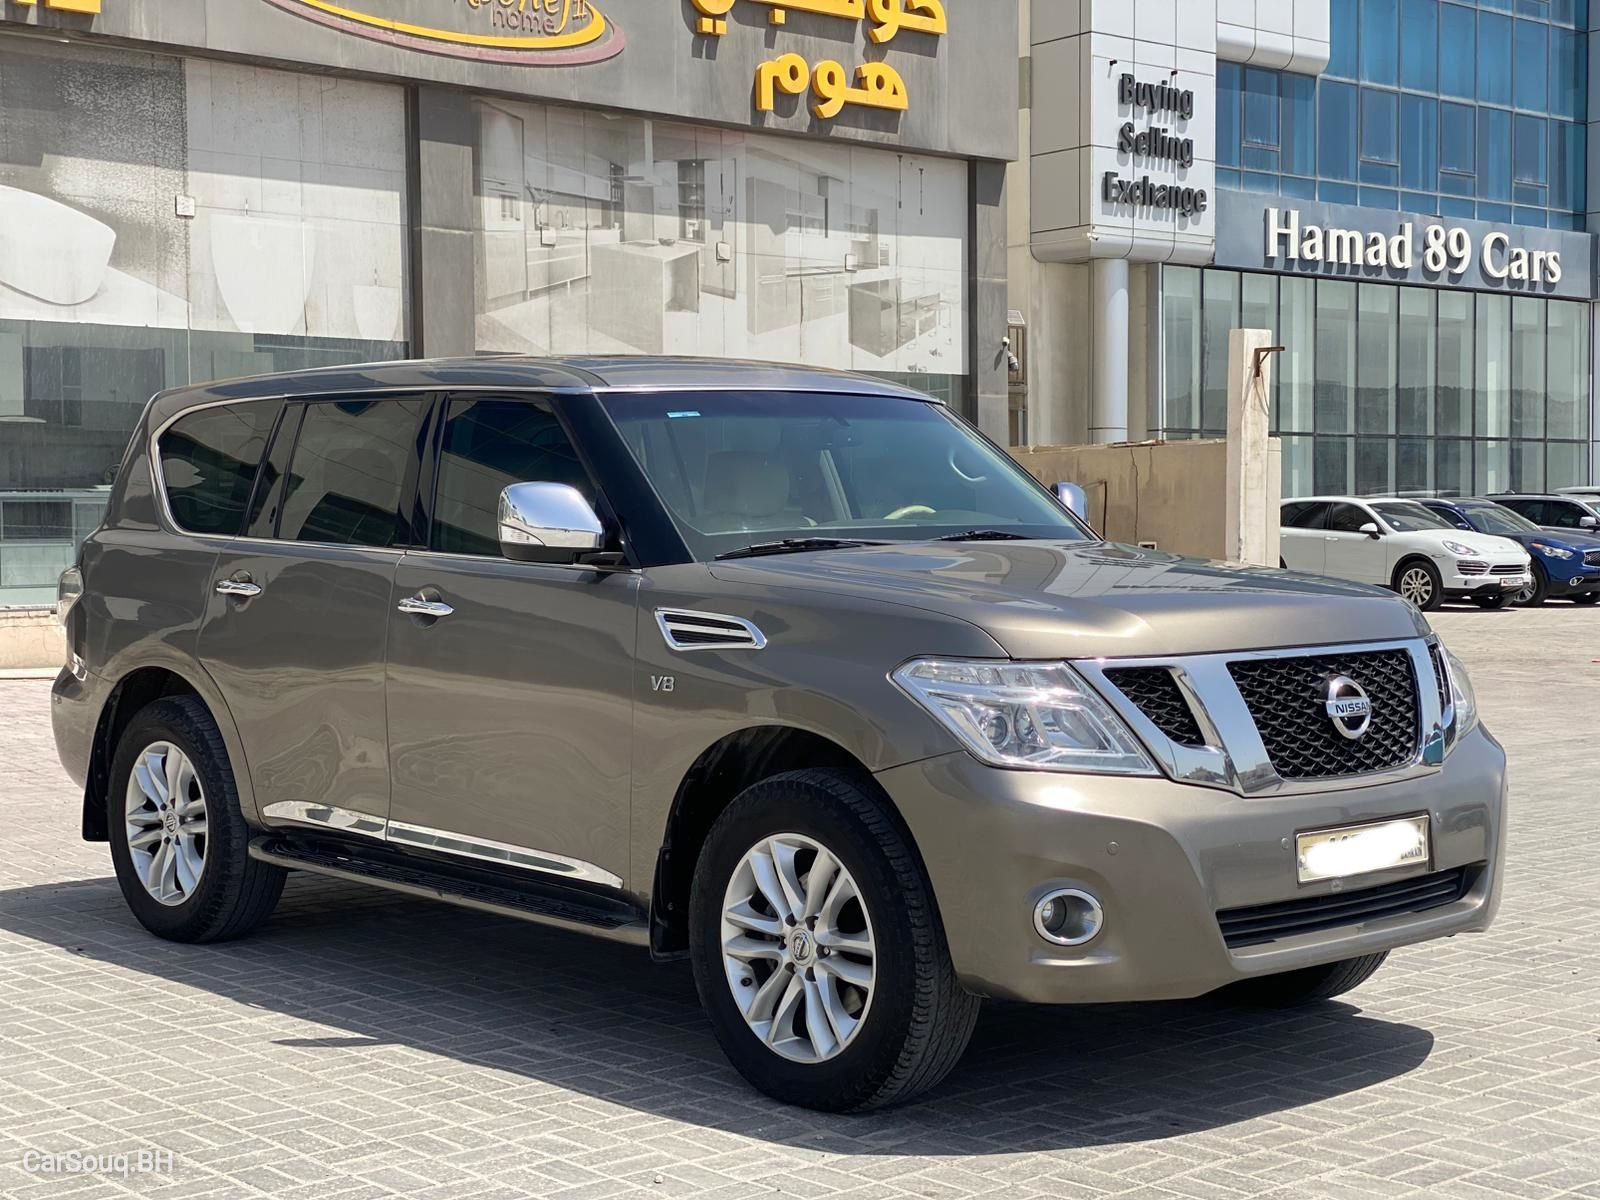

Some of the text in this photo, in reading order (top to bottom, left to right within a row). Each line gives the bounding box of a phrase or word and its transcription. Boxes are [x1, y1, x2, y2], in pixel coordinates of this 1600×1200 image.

[491, 3, 555, 36] home
[755, 53, 908, 119] هوم
[1119, 73, 1194, 120] Buying
[1118, 122, 1194, 168] Selling
[1102, 171, 1207, 217] Exchange
[1264, 207, 1562, 283] Hamad 89 Cars
[650, 675, 675, 692] V8
